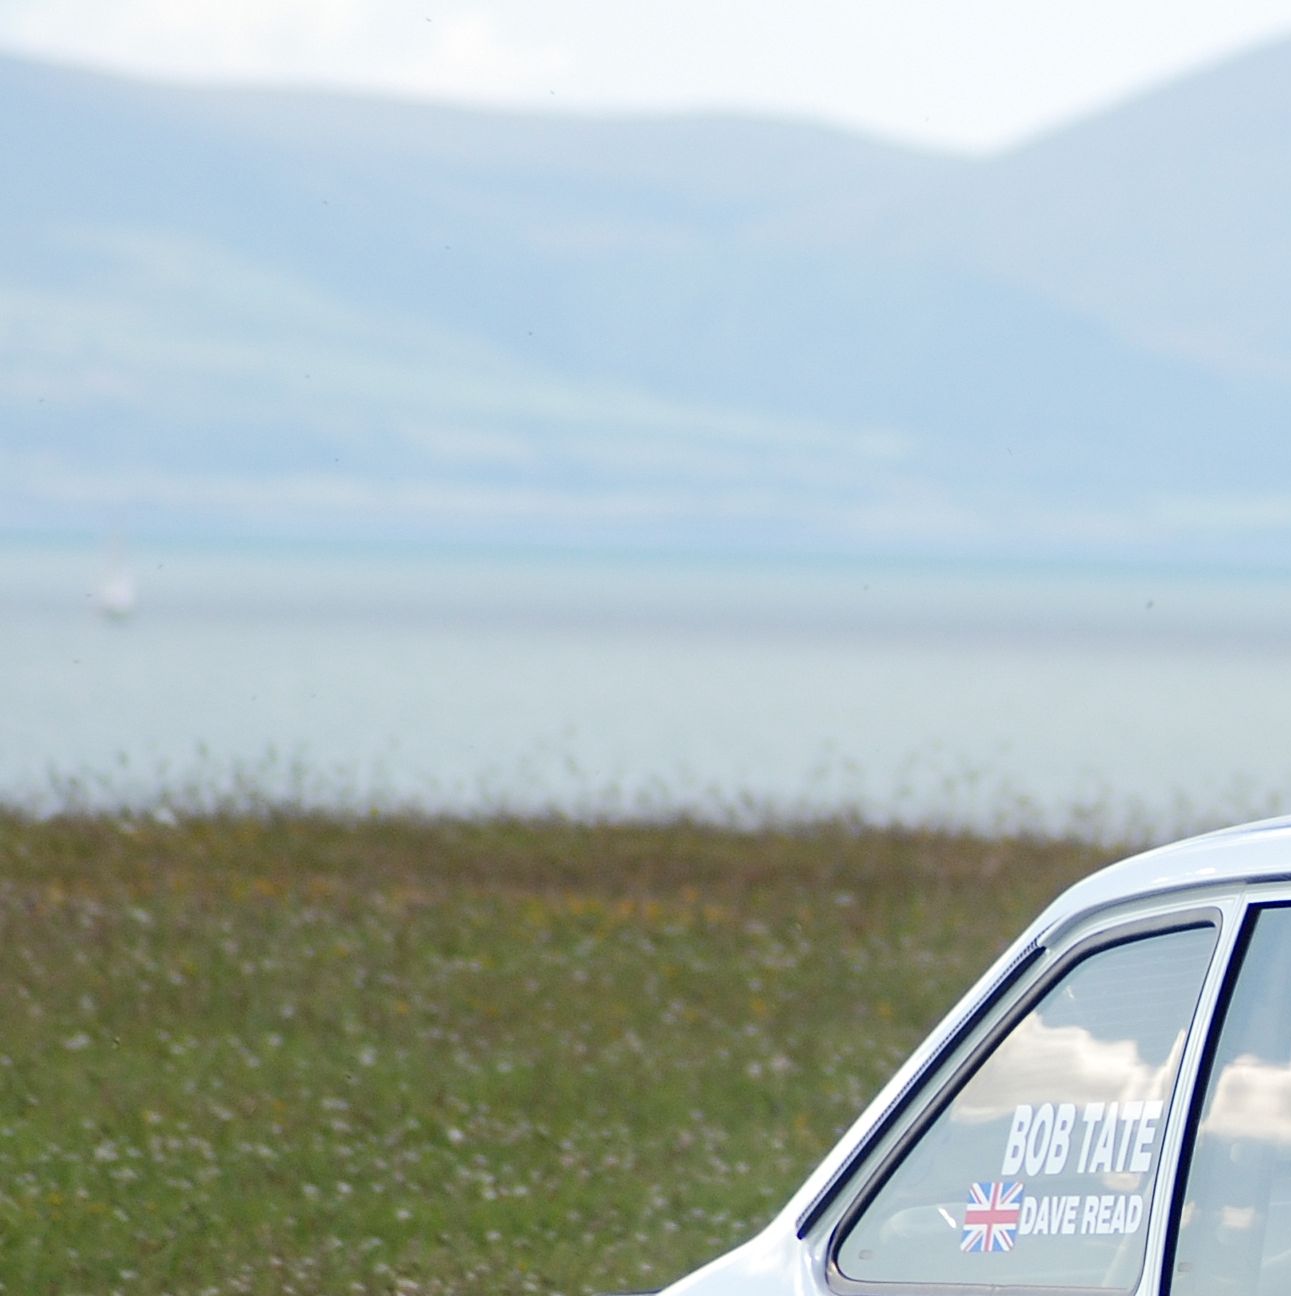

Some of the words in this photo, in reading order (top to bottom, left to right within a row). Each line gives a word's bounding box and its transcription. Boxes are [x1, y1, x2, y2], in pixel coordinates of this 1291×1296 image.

[1002, 1102, 1076, 1177] BOB
[1077, 1100, 1164, 1174] TATE
[1018, 1195, 1081, 1236] DAVE
[1081, 1194, 1143, 1235] READ
